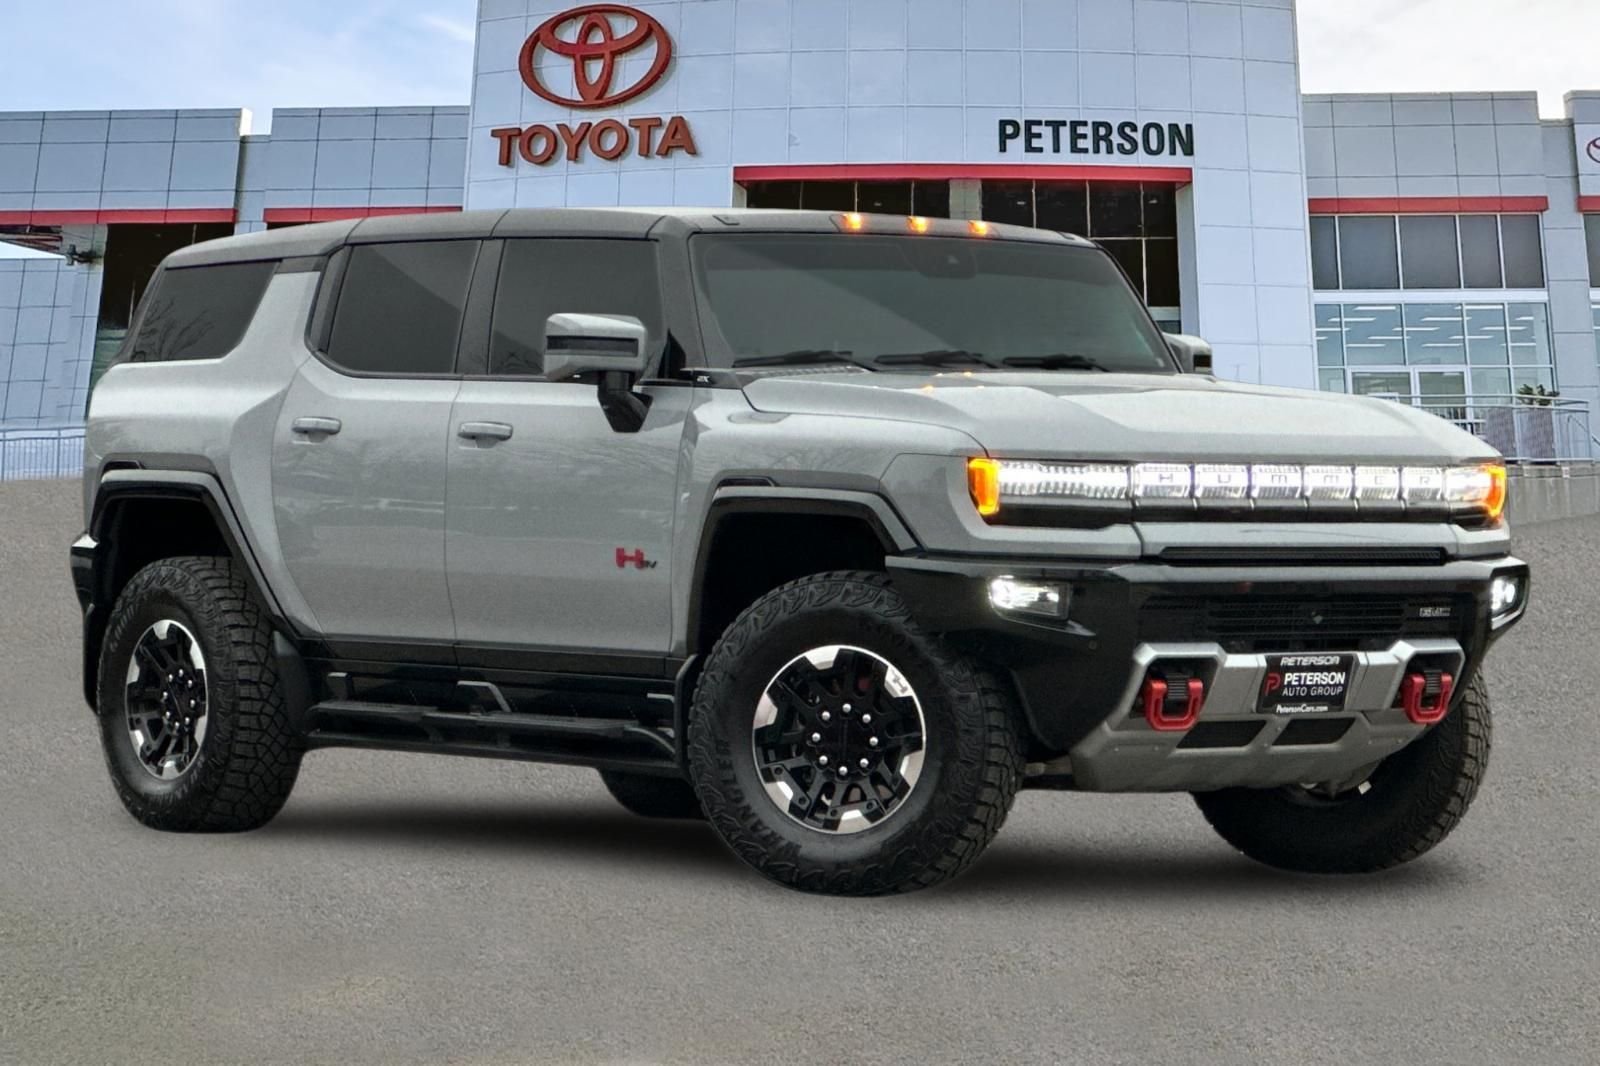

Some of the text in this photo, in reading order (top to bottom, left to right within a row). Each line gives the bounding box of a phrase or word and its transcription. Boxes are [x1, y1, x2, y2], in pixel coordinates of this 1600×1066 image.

[491, 115, 698, 167] TOYOTA
[998, 119, 1195, 156] PETERSON
[1282, 685, 1343, 696] AUTO GROUP
[1284, 671, 1346, 685] PETERSON
